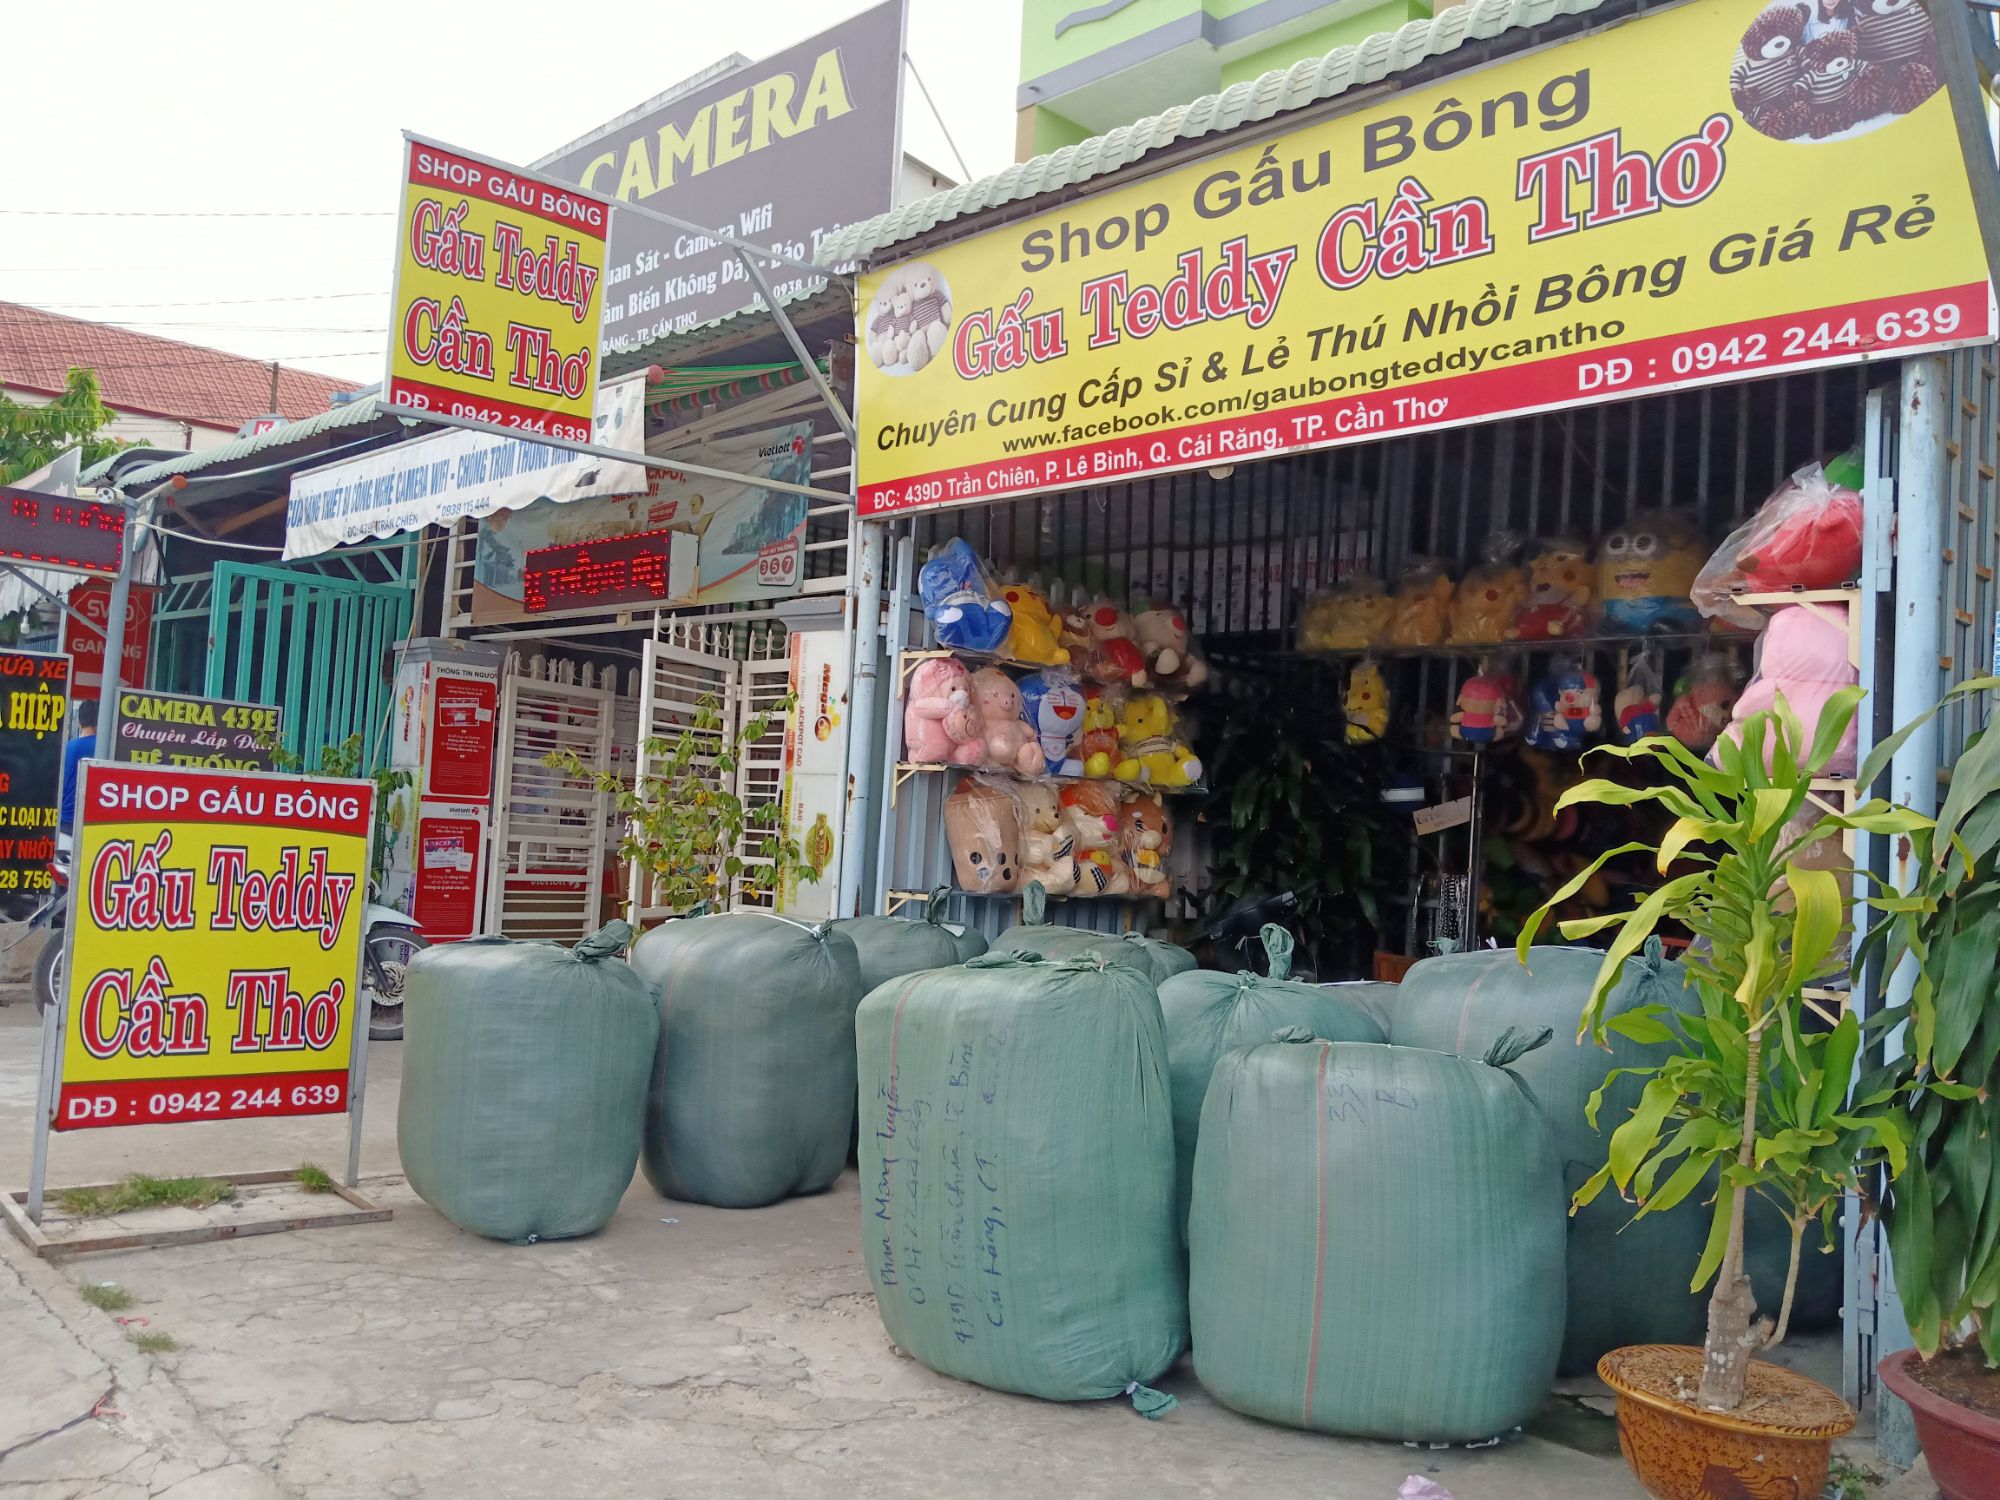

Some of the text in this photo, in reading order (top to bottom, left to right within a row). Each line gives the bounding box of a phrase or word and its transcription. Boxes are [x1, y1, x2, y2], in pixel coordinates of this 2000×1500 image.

[579, 46, 857, 201] CAMERA
[417, 153, 601, 226] SHOP GẤU BÔNG
[1020, 68, 1590, 273] Shop Gấu Bông
[411, 198, 598, 323] Gấu Teddy
[607, 263, 631, 286] uan
[636, 250, 660, 275] Sát
[674, 224, 734, 260] Camera
[740, 203, 772, 236] Wifi
[954, 112, 1733, 381] Gấu Teddy Cần Thơ
[628, 285, 660, 317] Biến
[665, 271, 717, 305] Không
[773, 279, 803, 298] 0938
[675, 310, 697, 328] THƠ
[877, 193, 1936, 451] Chuyên Cung Cấp Sỉ & Lẻ Thú Nhồi Bông Giá Rẻ
[404, 295, 590, 400] Cần Thơ
[1578, 356, 1633, 392] DĐ
[1672, 334, 1768, 375] 0942
[1782, 318, 1861, 357] 244
[1876, 302, 1961, 343] 639
[1002, 318, 1626, 453] www.facebook.com/gaubongteddycantho
[396, 390, 430, 411] DĐ
[451, 402, 503, 425] 0942
[509, 415, 546, 435] 244
[552, 423, 588, 443] 639
[758, 442, 791, 458] Vietlott
[874, 395, 1449, 510] ĐC: 439D Trần Chiên, P. Lê Bình, Q. Cái Răng, TP. Cần Thơ
[395, 465, 429, 504] CAMERA
[431, 459, 450, 495] WIFI
[646, 468, 687, 485] CKPOT,
[441, 503, 462, 518] 0938
[475, 497, 490, 512] 444
[0, 653, 69, 679] ỬA XE
[72, 637, 142, 659] GAMNG
[437, 666, 460, 676] THÔNG
[9, 682, 66, 740] HIỆP
[121, 695, 278, 732] CAMERA 439E
[121, 722, 187, 743] Chuyên
[190, 729, 229, 749] Lắp
[11, 807, 40, 830] LOẠI
[99, 782, 359, 820] SHOP GẤU BÔNG
[23, 871, 52, 889] 756
[89, 829, 356, 950] Gấu Teddy
[80, 955, 345, 1059] Cần Thơ
[68, 1096, 117, 1120] DĐ
[149, 1091, 221, 1115] 0942
[231, 1087, 282, 1110] 244
[291, 1084, 340, 1107] 639
